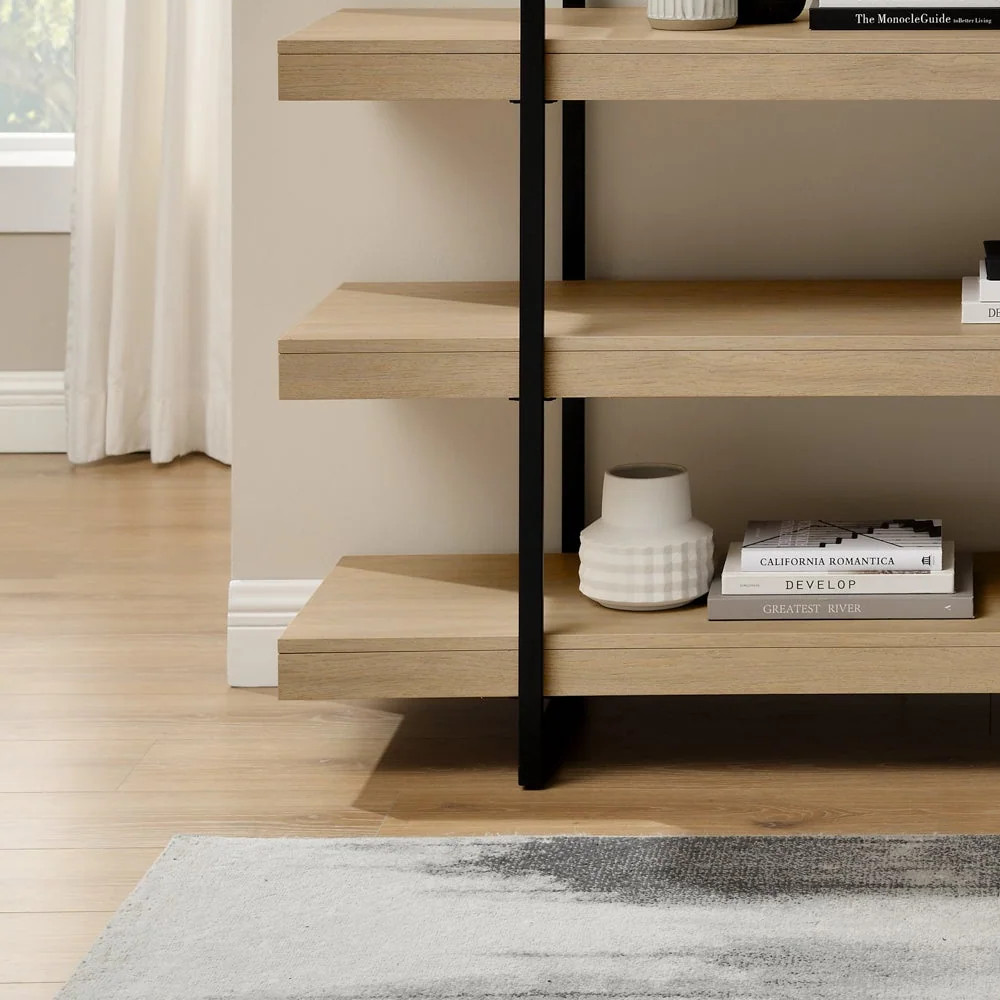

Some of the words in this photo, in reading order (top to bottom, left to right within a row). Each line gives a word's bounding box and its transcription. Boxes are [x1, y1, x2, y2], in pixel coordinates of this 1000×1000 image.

[855, 13, 875, 24] The
[975, 17, 992, 25] Living
[759, 557, 825, 566] CALIFORNIA
[829, 557, 895, 566] ROMANTICA
[785, 580, 856, 590] DEVELOP
[763, 604, 820, 614] GREATEST
[828, 604, 862, 613] RIVER
